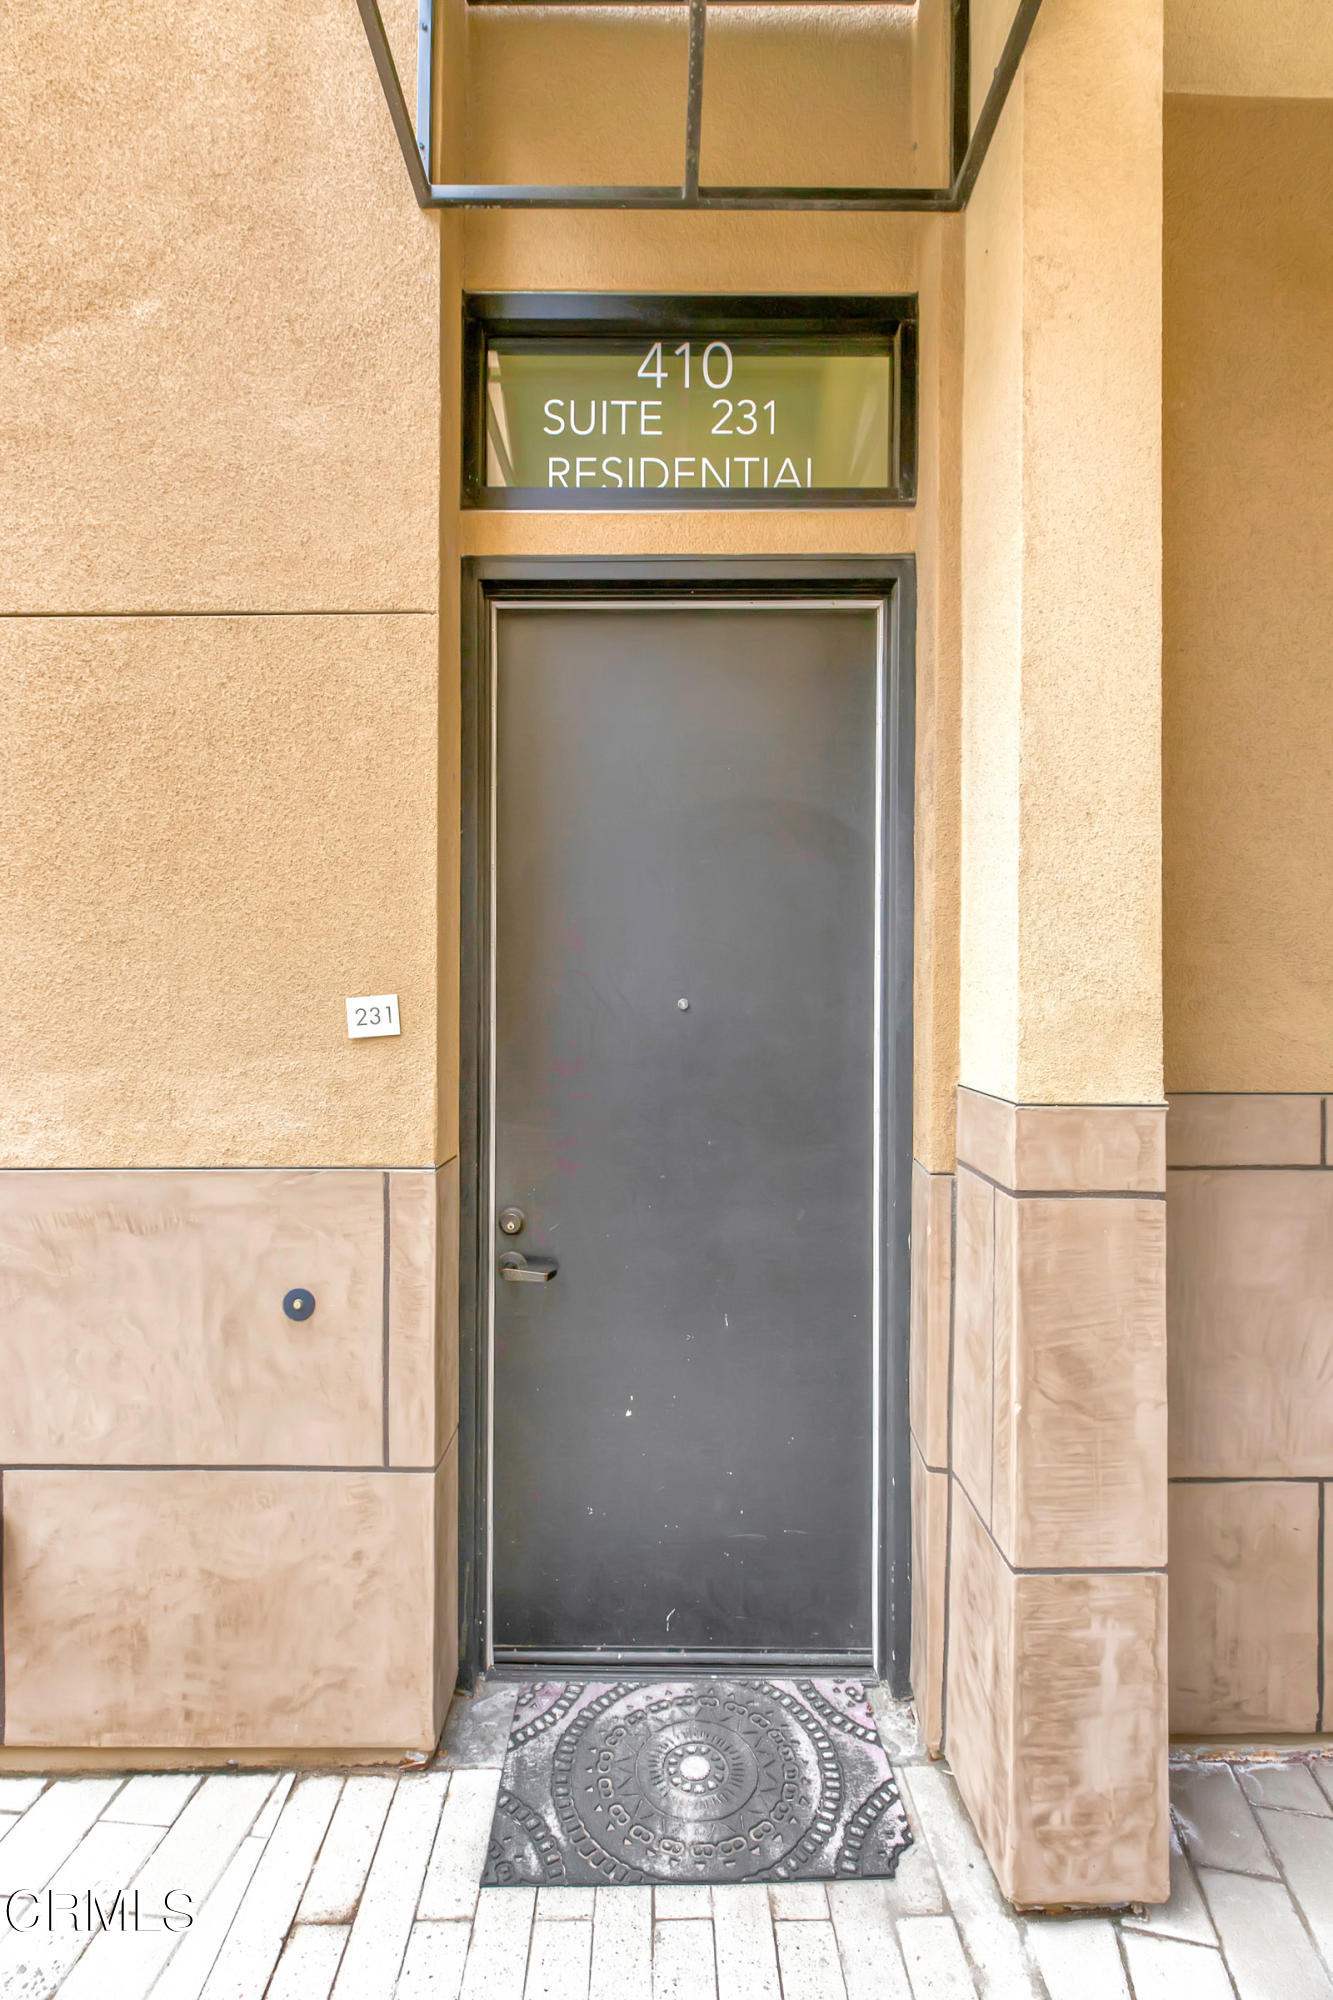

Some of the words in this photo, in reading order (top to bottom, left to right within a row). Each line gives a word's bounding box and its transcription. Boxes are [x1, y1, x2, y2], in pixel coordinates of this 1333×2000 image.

[637, 341, 734, 389] 410
[543, 399, 663, 436] SUITE
[710, 399, 777, 436] 231
[355, 1006, 392, 1026] 231
